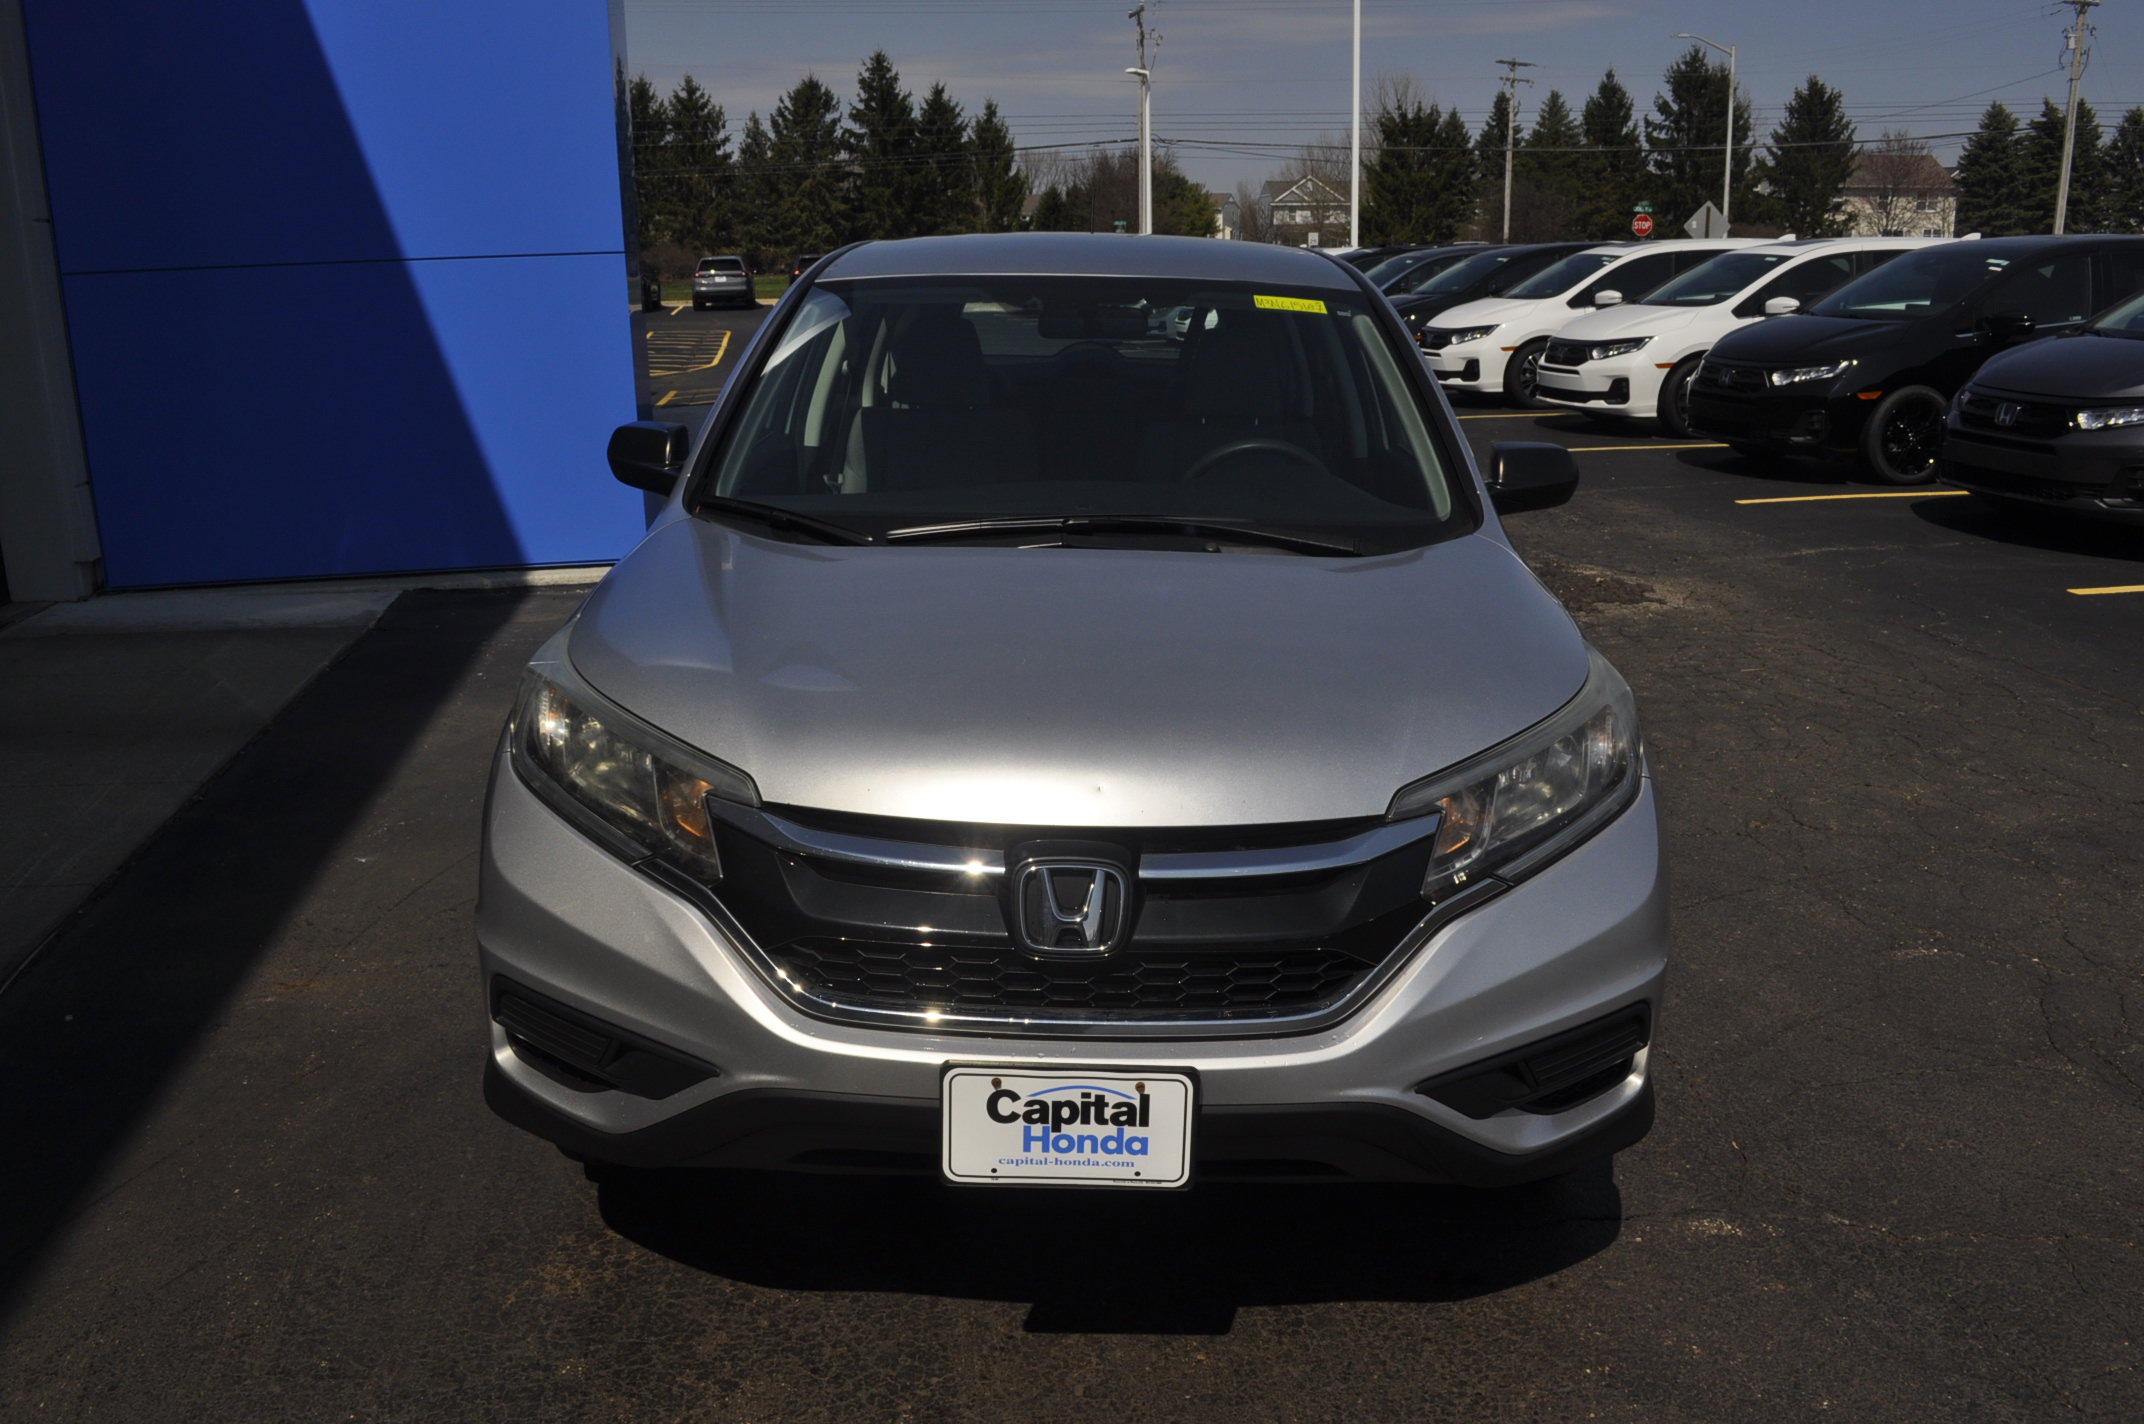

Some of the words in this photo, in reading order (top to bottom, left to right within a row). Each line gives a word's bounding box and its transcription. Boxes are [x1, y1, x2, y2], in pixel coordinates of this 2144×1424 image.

[1634, 221, 1651, 230] STOP
[986, 1089, 1151, 1133] Capital
[1022, 1125, 1149, 1156] Honda
[998, 1156, 1136, 1168] capital-honda.com
